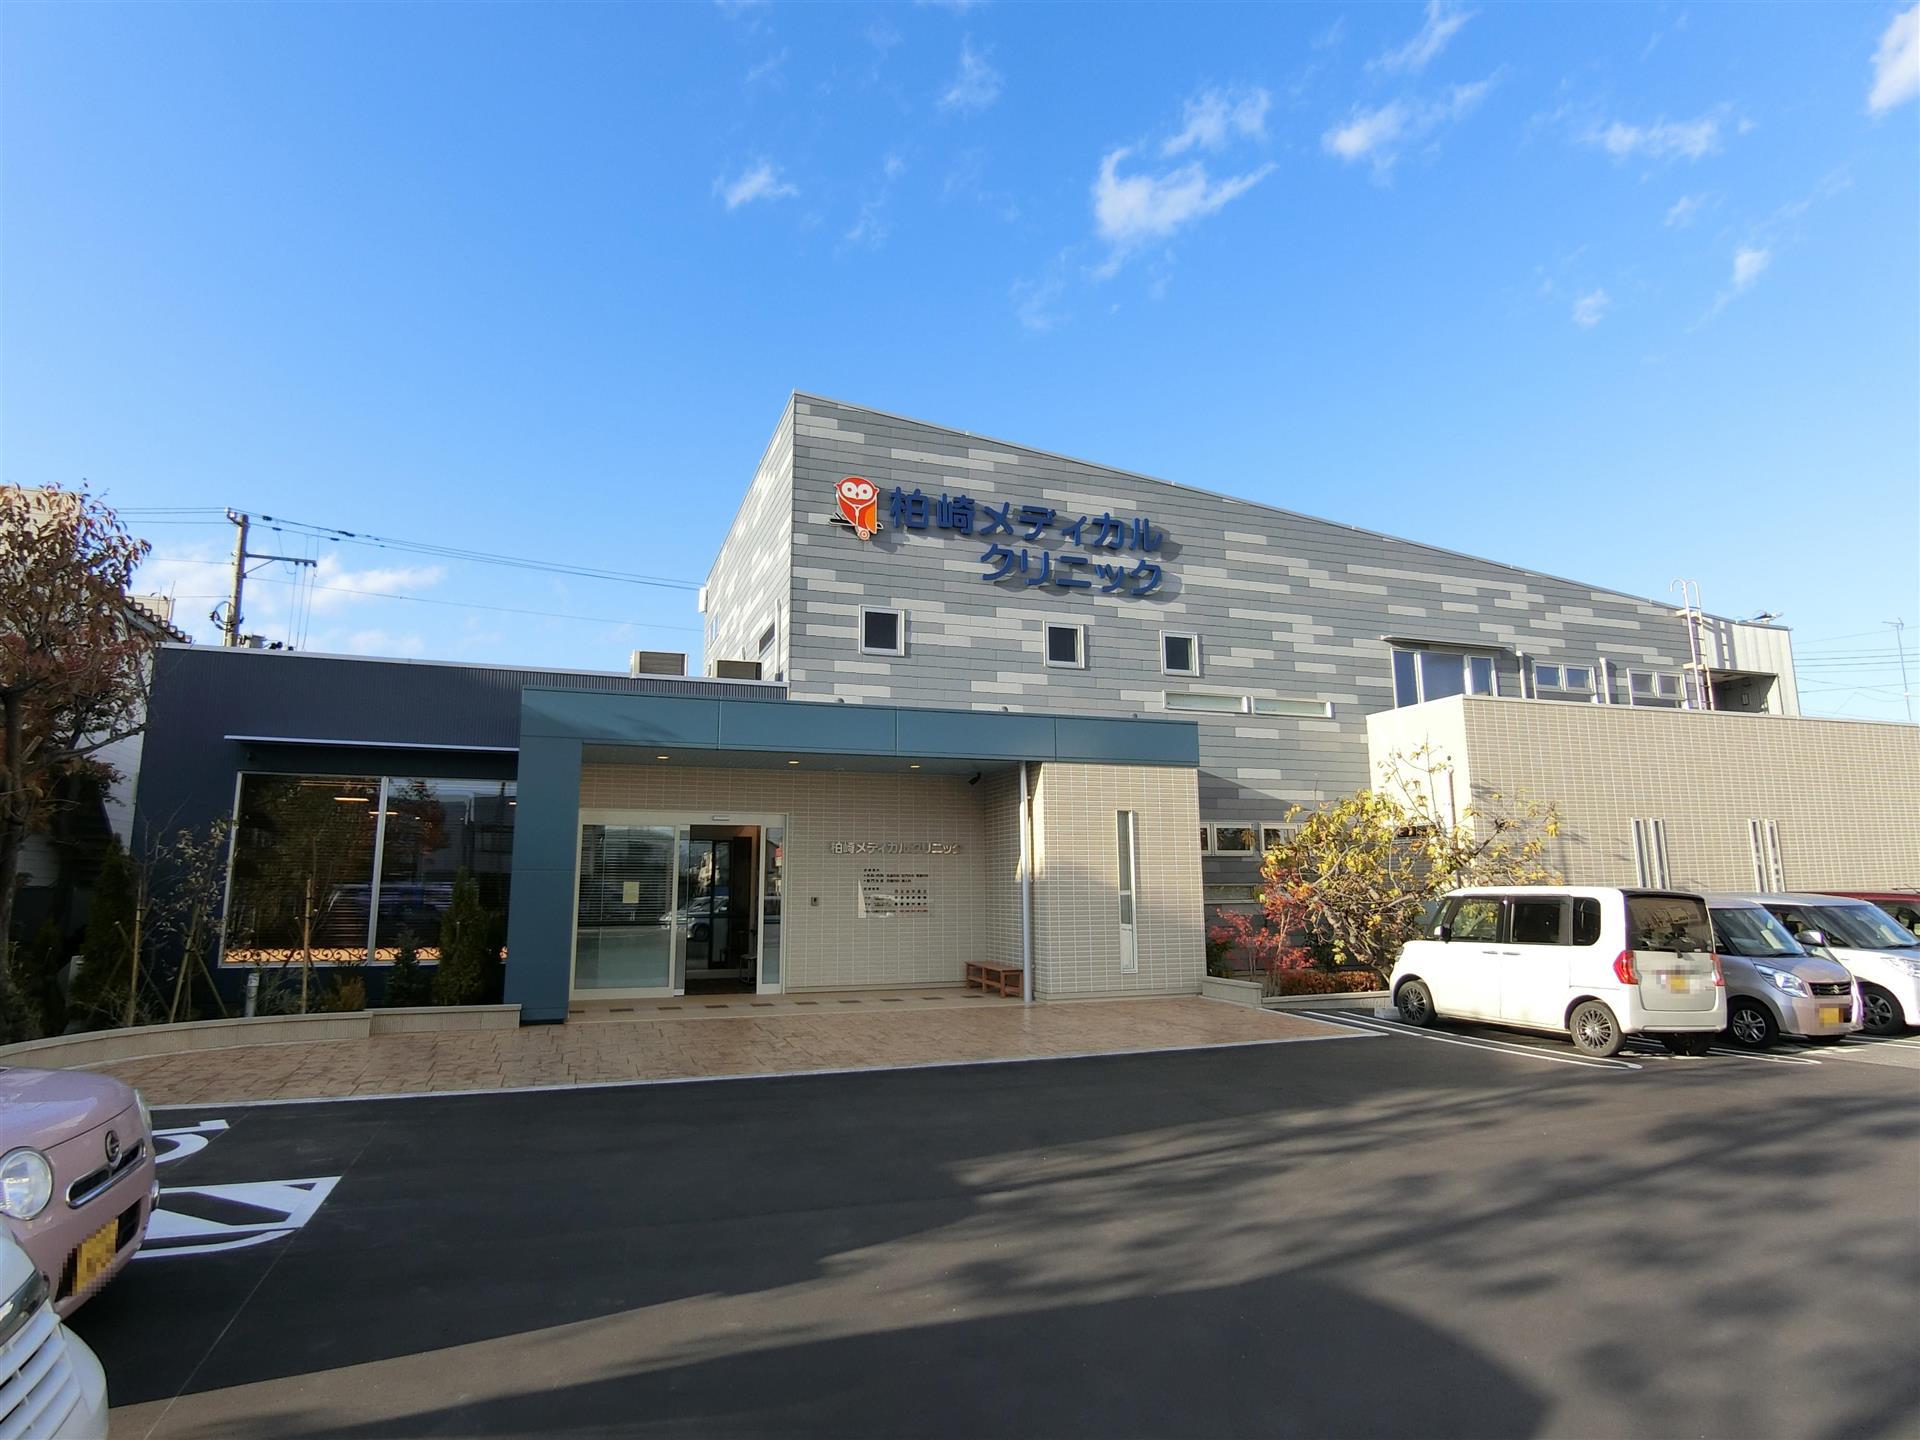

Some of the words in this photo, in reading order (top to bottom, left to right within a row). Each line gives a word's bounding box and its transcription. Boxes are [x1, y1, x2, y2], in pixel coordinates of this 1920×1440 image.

[889, 486, 1163, 553] 柏崎メディカル
[980, 543, 1163, 596] クリニック
